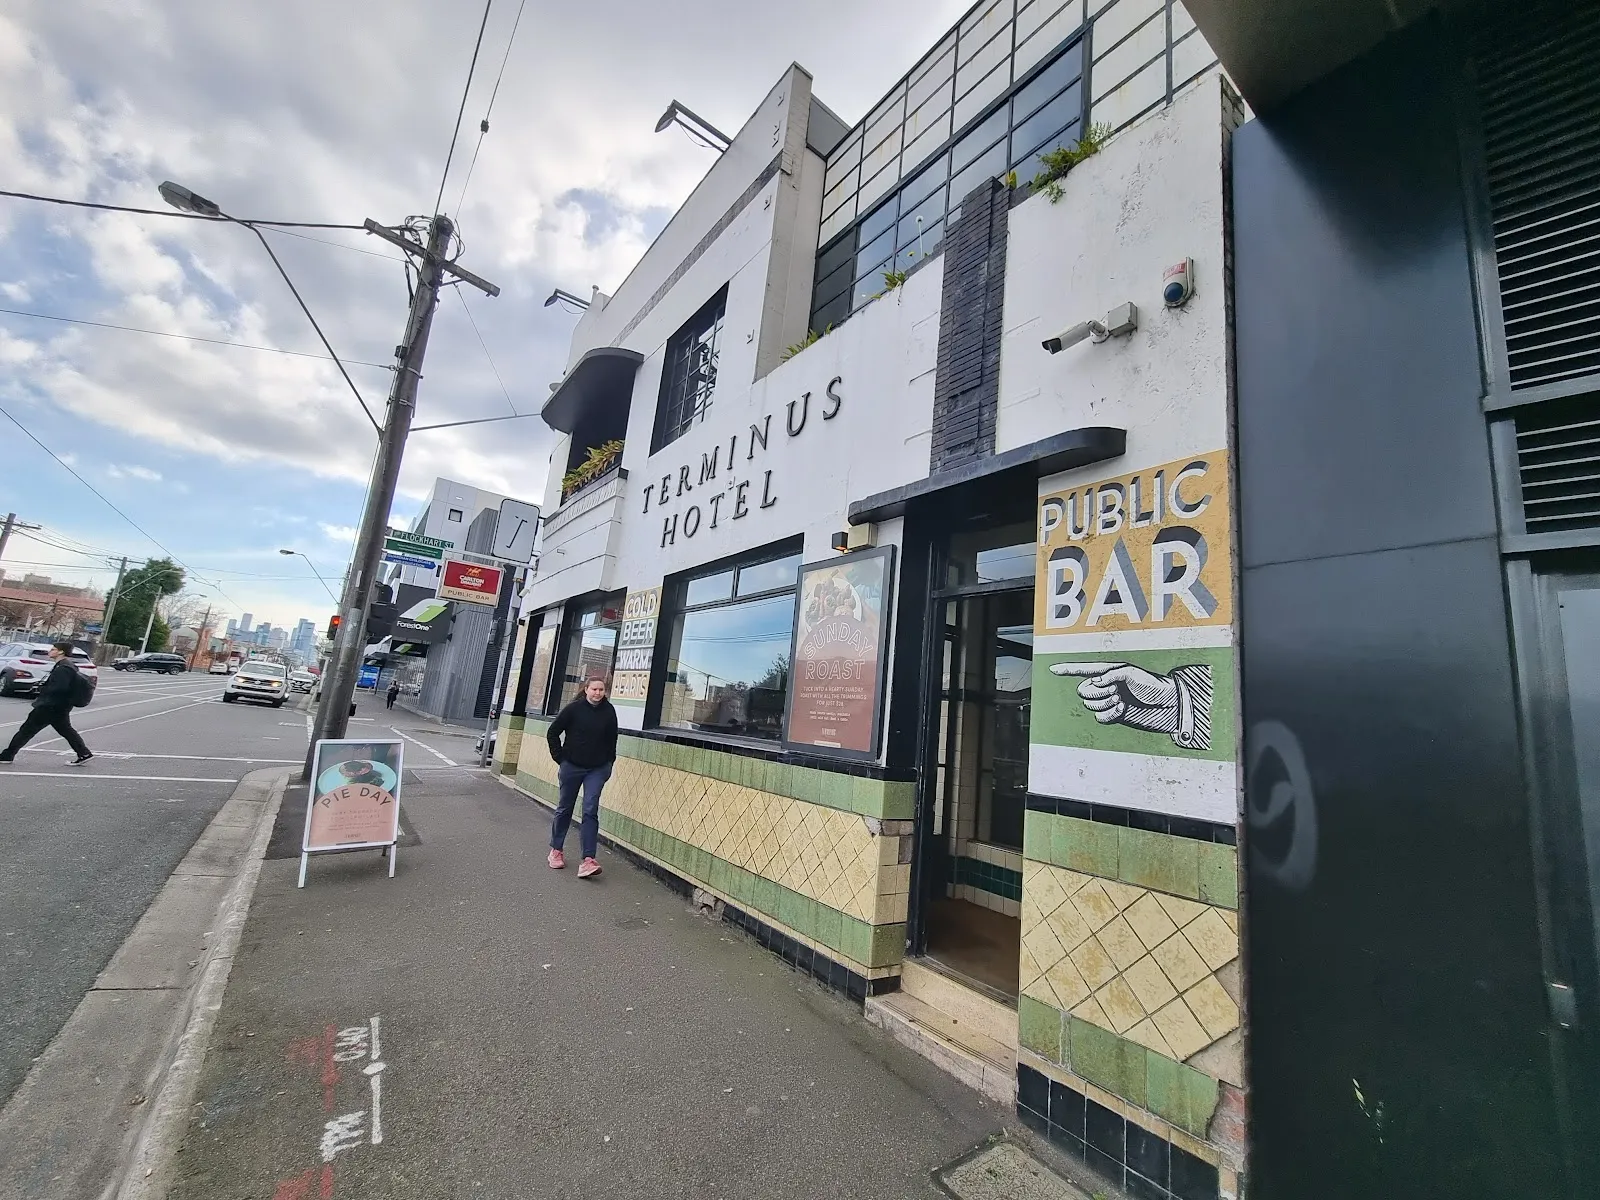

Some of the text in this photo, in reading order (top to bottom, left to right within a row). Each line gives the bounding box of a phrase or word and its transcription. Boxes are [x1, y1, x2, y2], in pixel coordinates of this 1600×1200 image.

[642, 375, 842, 514] TERMINUS
[660, 469, 778, 548] HOTEL
[1039, 460, 1213, 547] PUBLIC
[401, 532, 454, 549] FLOCKHART ST
[460, 575, 485, 585] CARLTON
[1045, 525, 1220, 630] BAR
[447, 590, 473, 599] PUBLIC
[626, 591, 657, 619] COLD
[622, 619, 654, 642] BEER
[804, 622, 873, 660] SUNDAY
[620, 649, 650, 670] WARM
[805, 660, 865, 680] ROAST
[614, 673, 647, 697] HEARTS
[321, 787, 391, 808] PIE DAY
